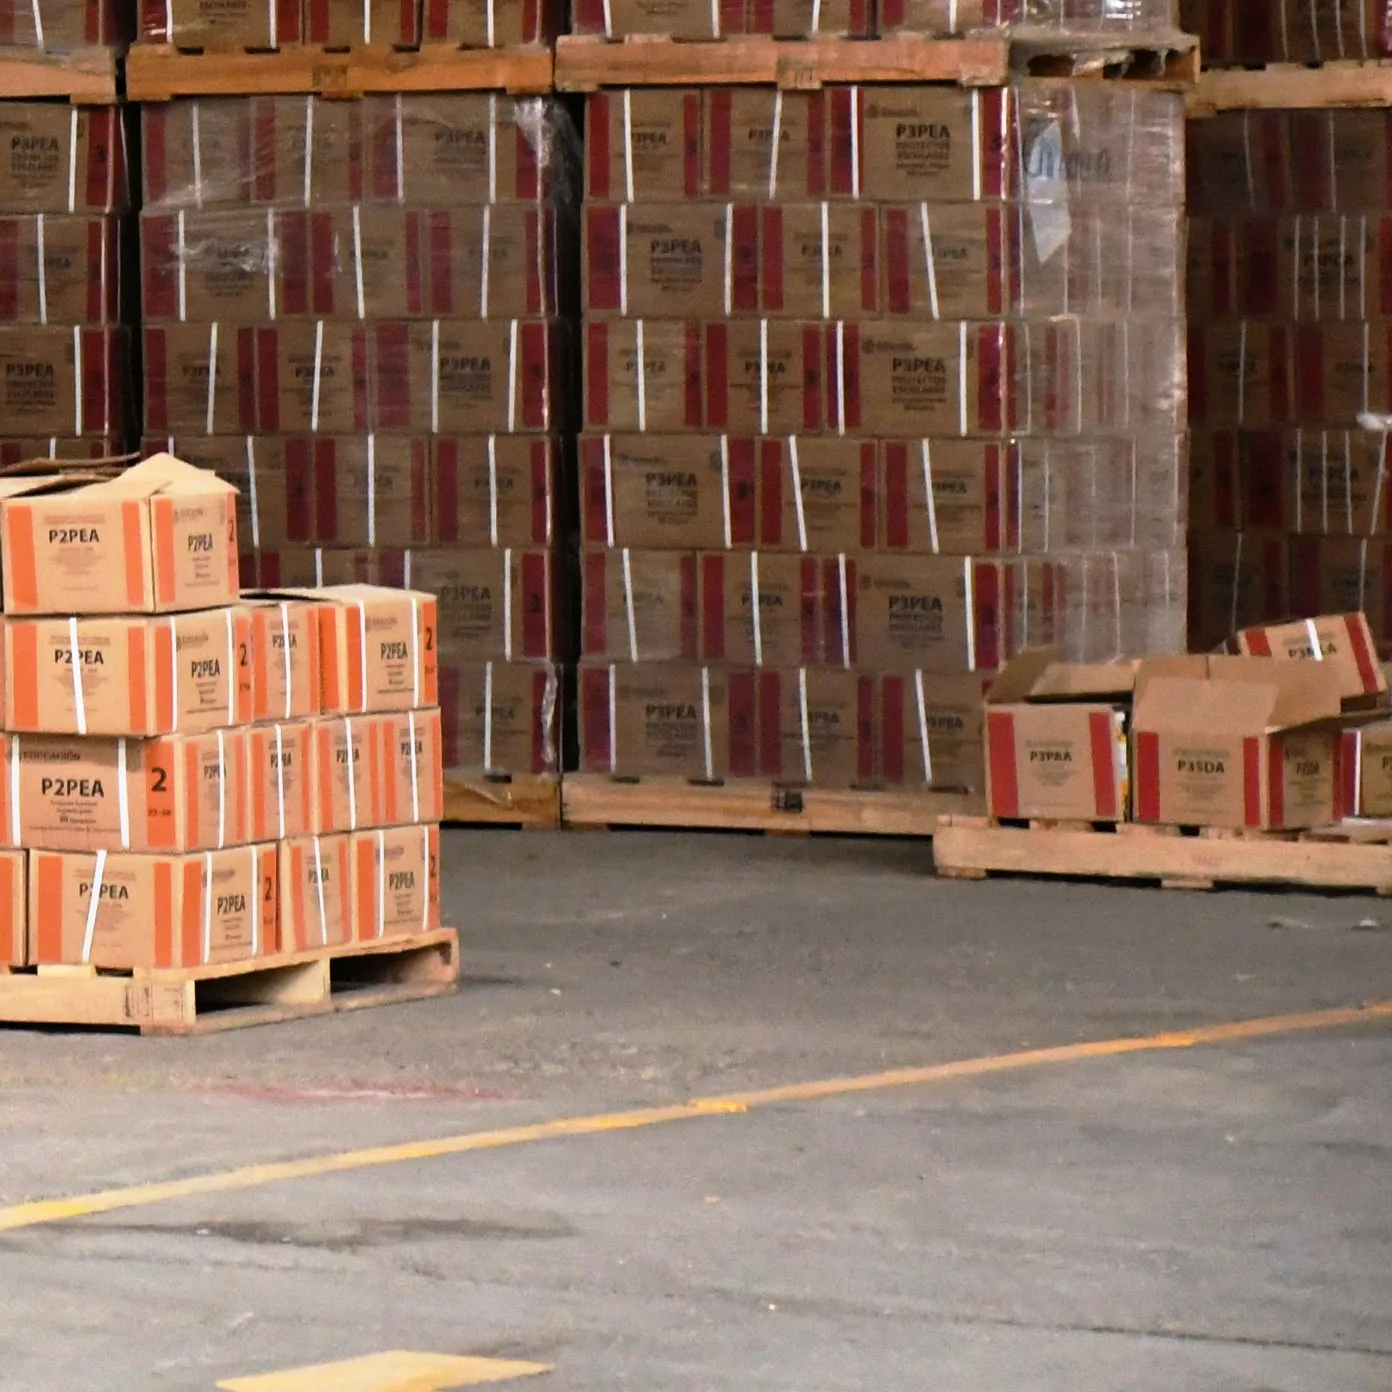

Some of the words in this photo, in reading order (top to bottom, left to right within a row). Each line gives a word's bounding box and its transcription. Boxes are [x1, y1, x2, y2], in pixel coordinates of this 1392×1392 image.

[48, 529, 100, 543] P2PEA
[187, 534, 213, 552] P2PEA
[381, 642, 408, 660] P2PEA
[192, 659, 220, 678] P2PEA
[42, 778, 104, 798] P2PEA
[151, 767, 167, 792] 2
[389, 872, 415, 890] P2PEA
[217, 895, 246, 915] P2PEA
